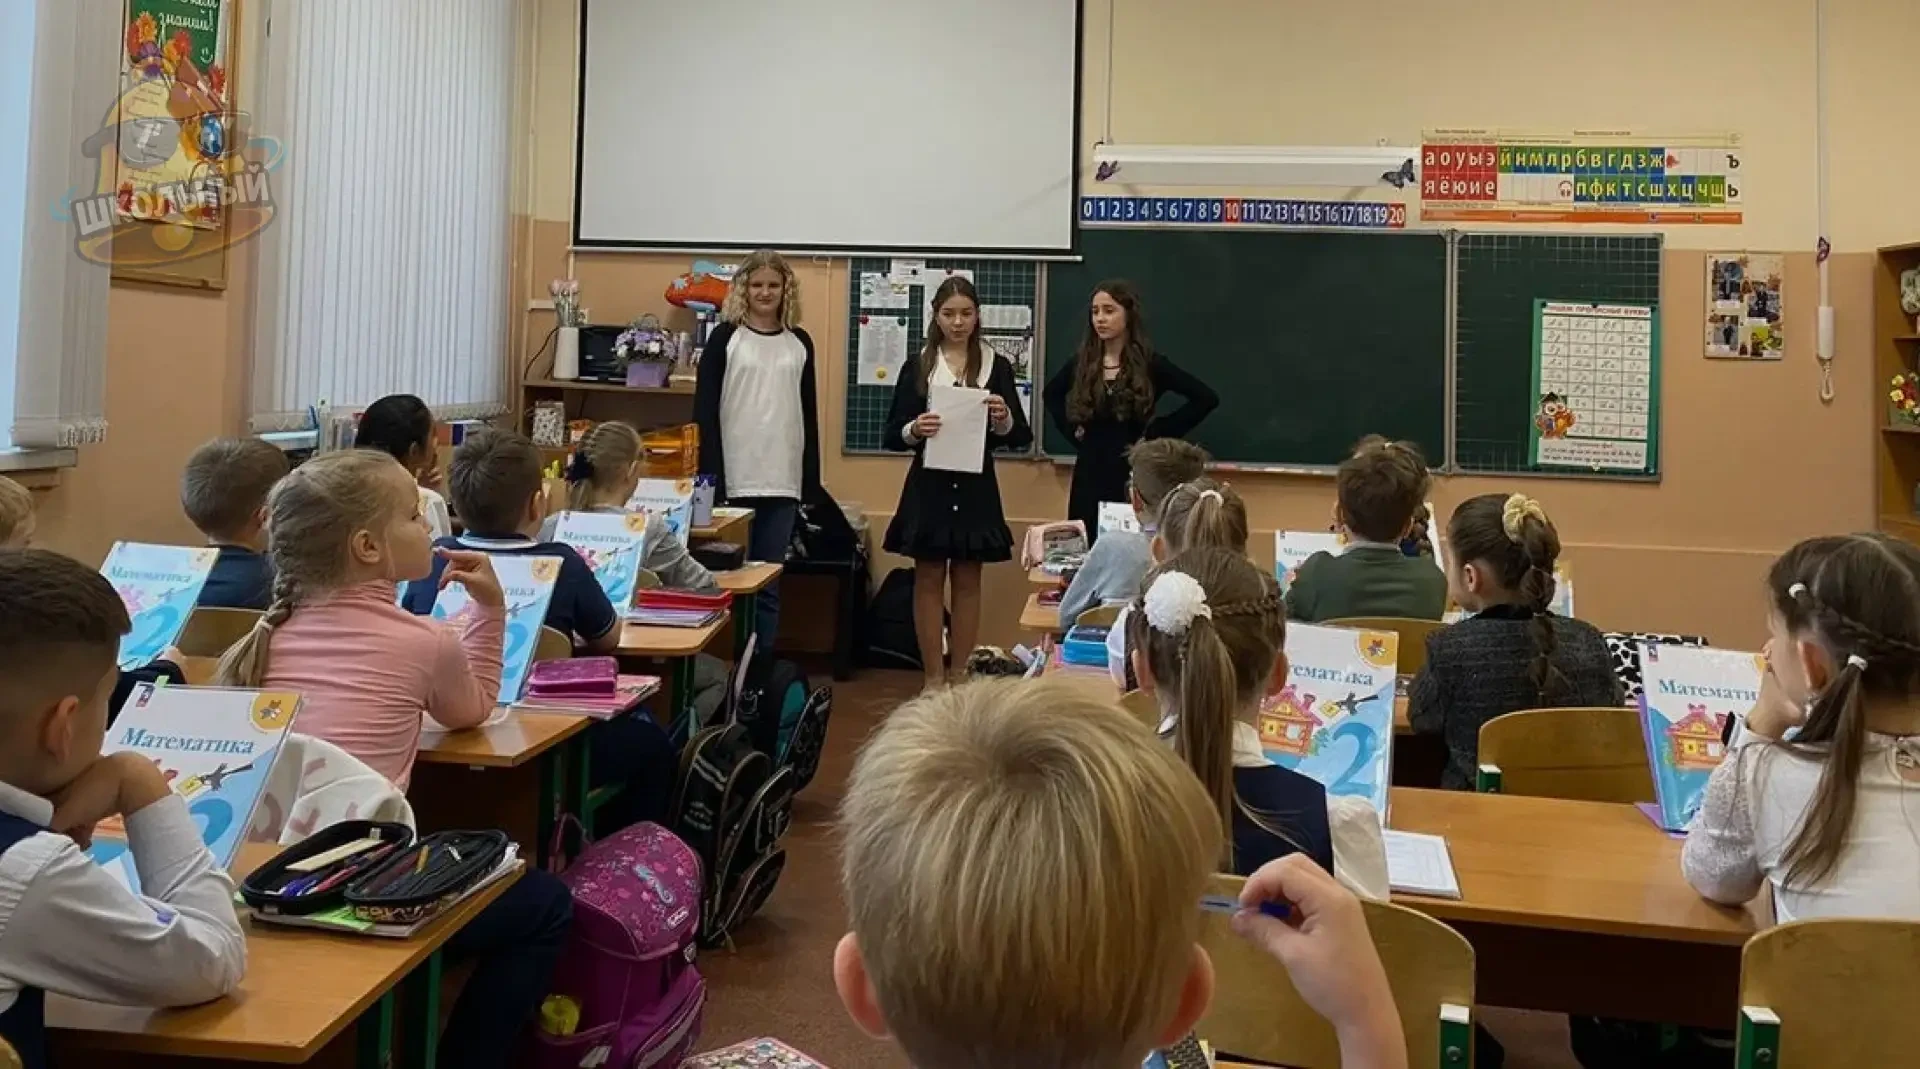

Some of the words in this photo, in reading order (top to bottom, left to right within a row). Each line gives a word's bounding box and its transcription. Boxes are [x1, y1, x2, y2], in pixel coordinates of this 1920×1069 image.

[1084, 202, 1091, 217] 0
[1099, 202, 1105, 217] 1
[1112, 202, 1120, 218] 2
[1127, 203, 1134, 217] 3
[1140, 203, 1149, 218] 4
[1155, 203, 1163, 218] 5
[1169, 203, 1178, 218] 6
[1184, 203, 1192, 218] 7
[1199, 203, 1207, 218] 8
[1212, 203, 1221, 219] 9
[1226, 203, 1239, 219] 10
[1243, 203, 1254, 220] 11
[1259, 203, 1271, 220] 12
[1275, 203, 1288, 220] 13
[1292, 203, 1305, 221] 14
[1308, 204, 1321, 221] 15
[1324, 205, 1338, 222] 16
[1341, 205, 1354, 222] 17
[1357, 206, 1371, 223] 18
[1374, 206, 1387, 224] 19
[1390, 207, 1404, 223] 20
[563, 532, 631, 543] Математика
[109, 566, 193, 583] Математика
[127, 605, 179, 657] 2
[1658, 678, 1757, 701] Математи
[118, 726, 255, 754] Математика
[1330, 722, 1377, 798] 2
